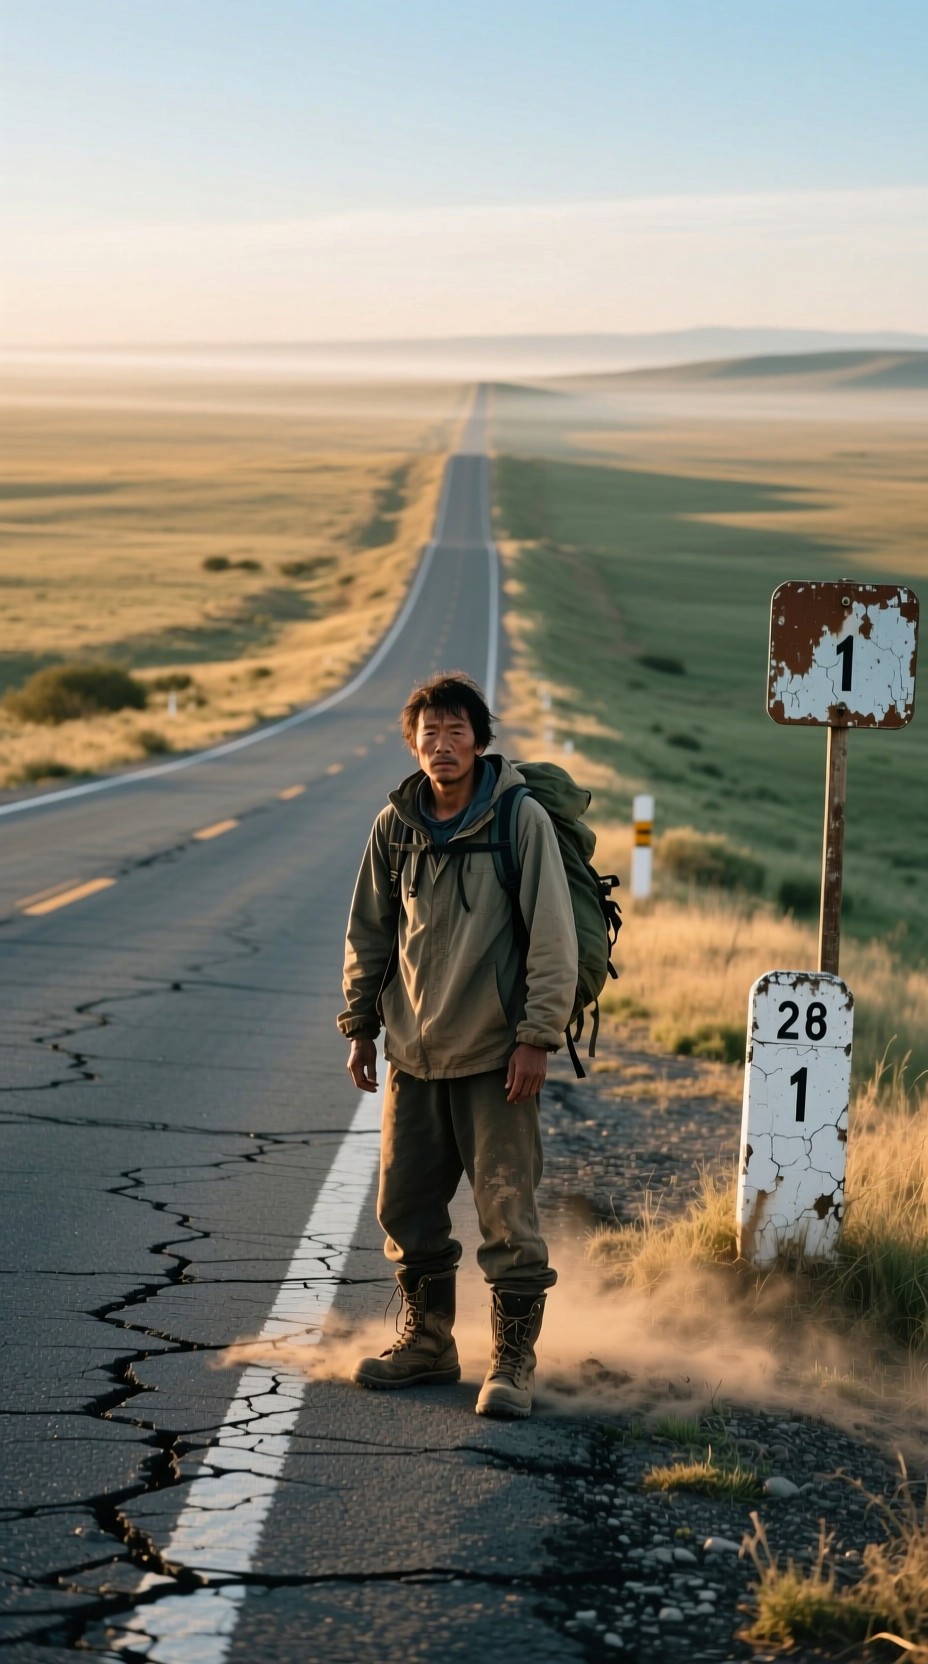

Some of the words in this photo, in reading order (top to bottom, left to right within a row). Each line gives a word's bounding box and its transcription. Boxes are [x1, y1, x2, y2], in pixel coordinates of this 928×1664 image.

[836, 634, 854, 692] 1
[777, 1000, 828, 1041] 28
[789, 1066, 808, 1122] 1
